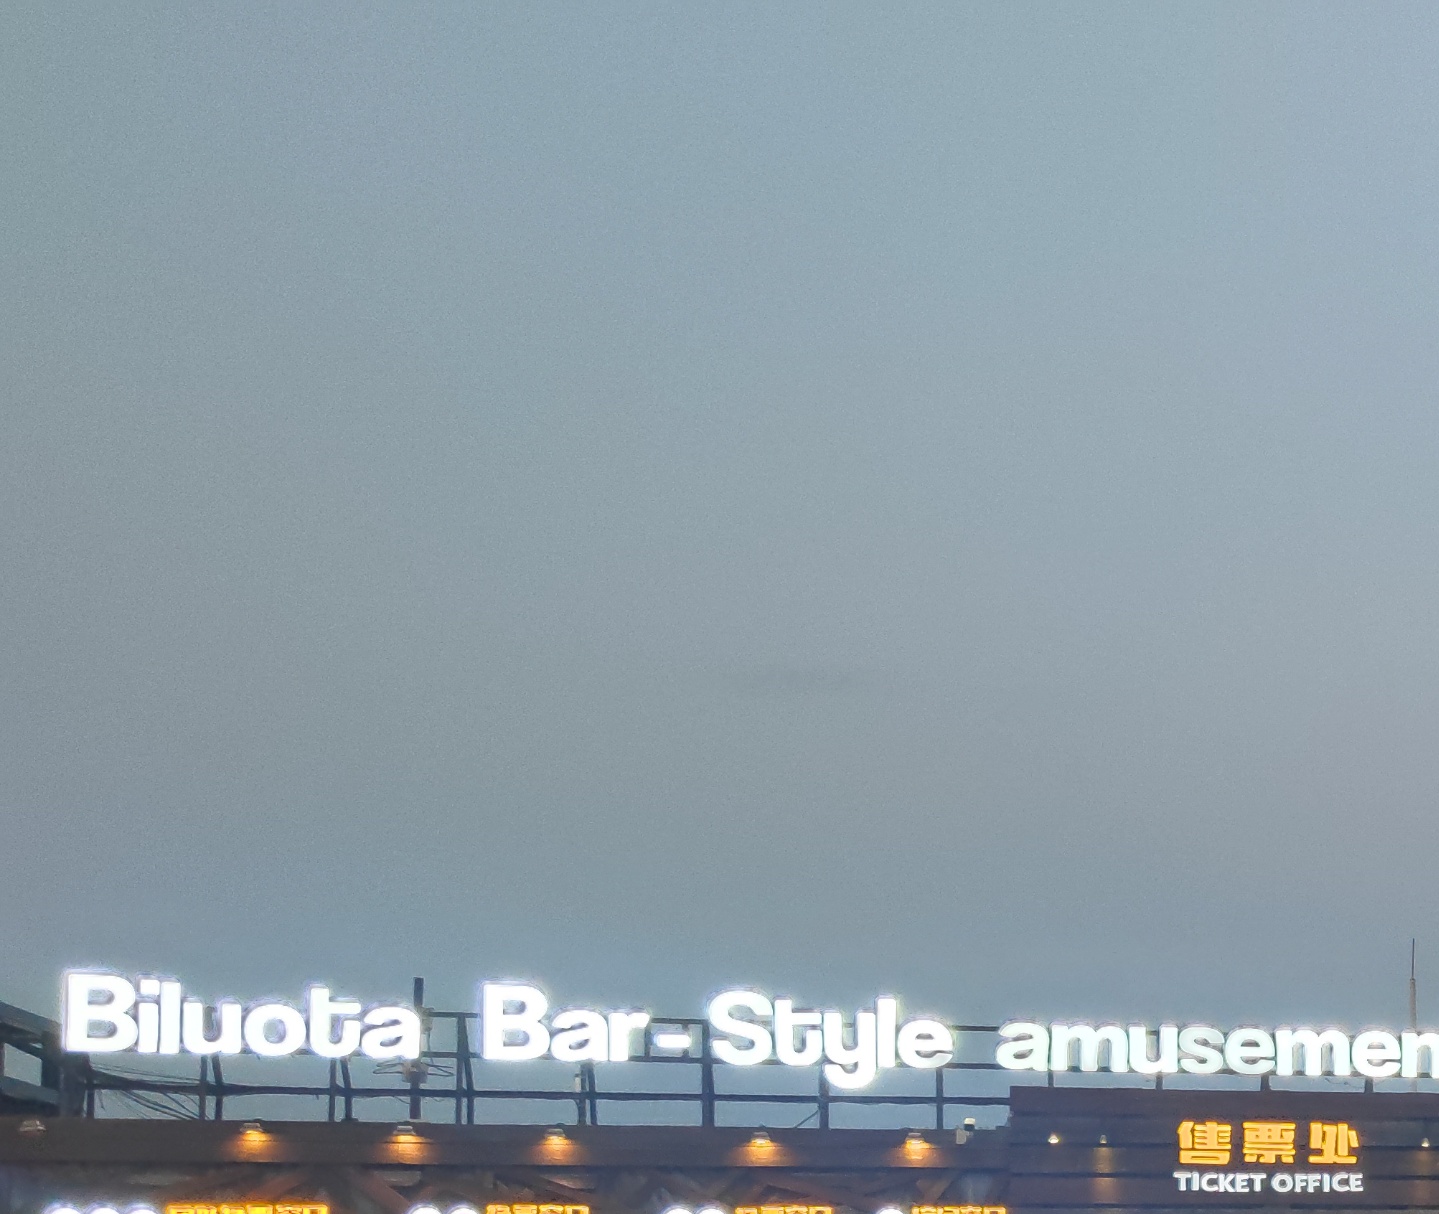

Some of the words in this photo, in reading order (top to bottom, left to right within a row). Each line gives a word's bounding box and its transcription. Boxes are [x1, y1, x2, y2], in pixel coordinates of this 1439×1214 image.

[62, 971, 421, 1061] Biluota
[479, 980, 955, 1089] Bar-Style
[1177, 1119, 1360, 1166] 售票处
[1174, 1171, 1266, 1194] TICKET
[1271, 1171, 1364, 1194] OFFICE
